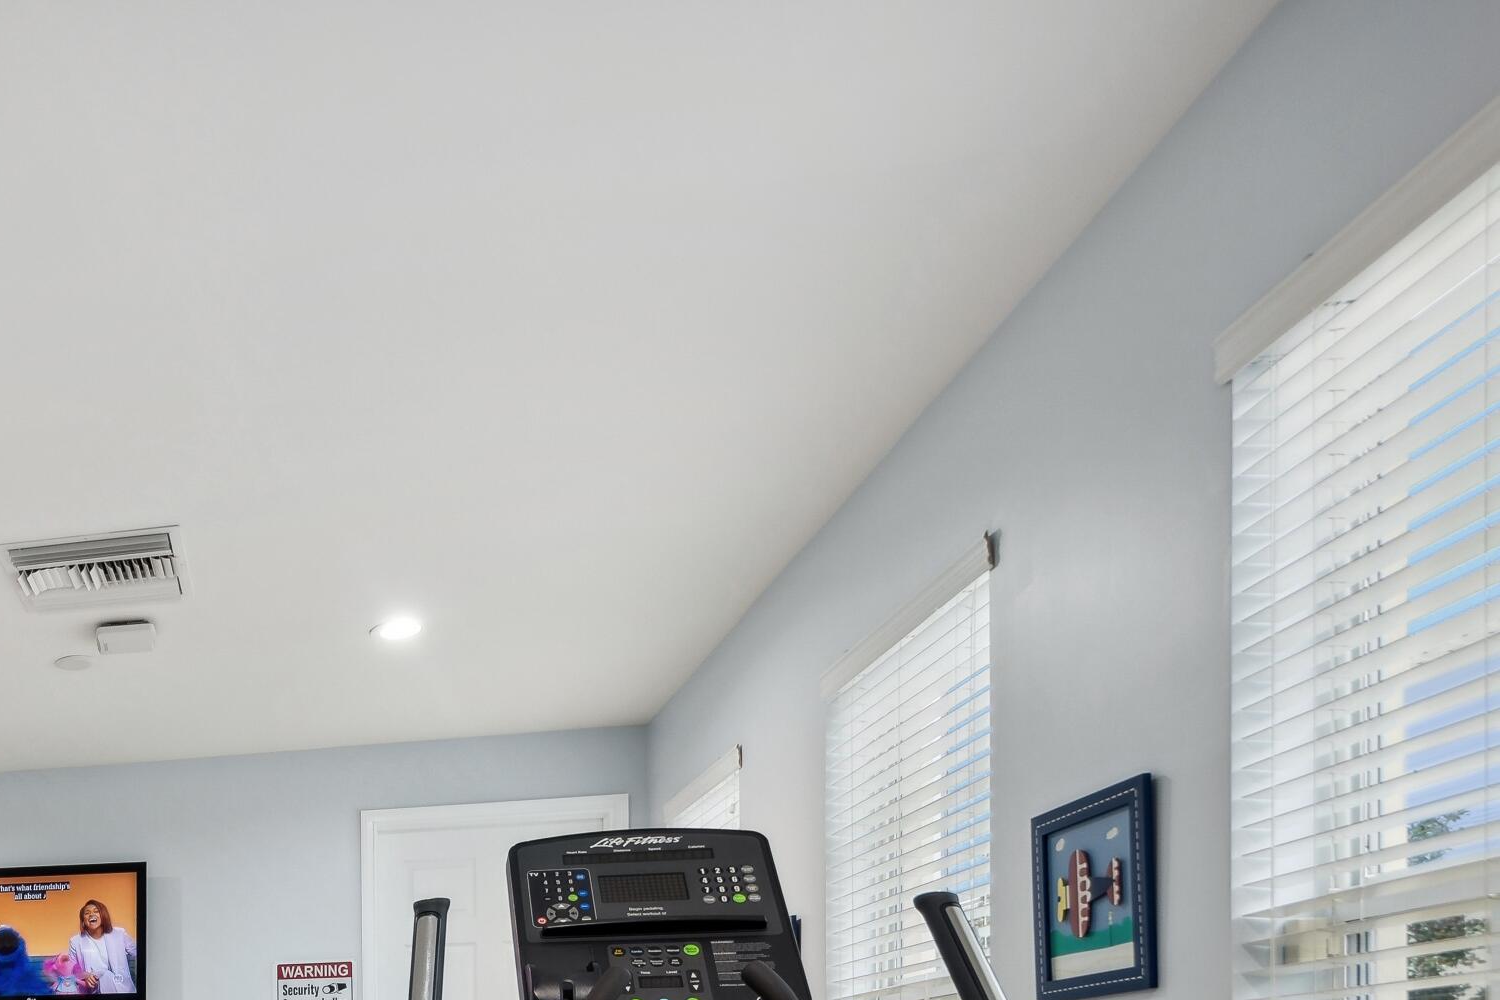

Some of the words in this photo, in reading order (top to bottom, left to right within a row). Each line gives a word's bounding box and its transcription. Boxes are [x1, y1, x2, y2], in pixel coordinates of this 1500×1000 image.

[590, 837, 625, 848] Life
[622, 836, 681, 847] Fitness
[33, 882, 70, 891] friendship's
[281, 964, 349, 978] WARNING
[282, 984, 319, 997] Security
